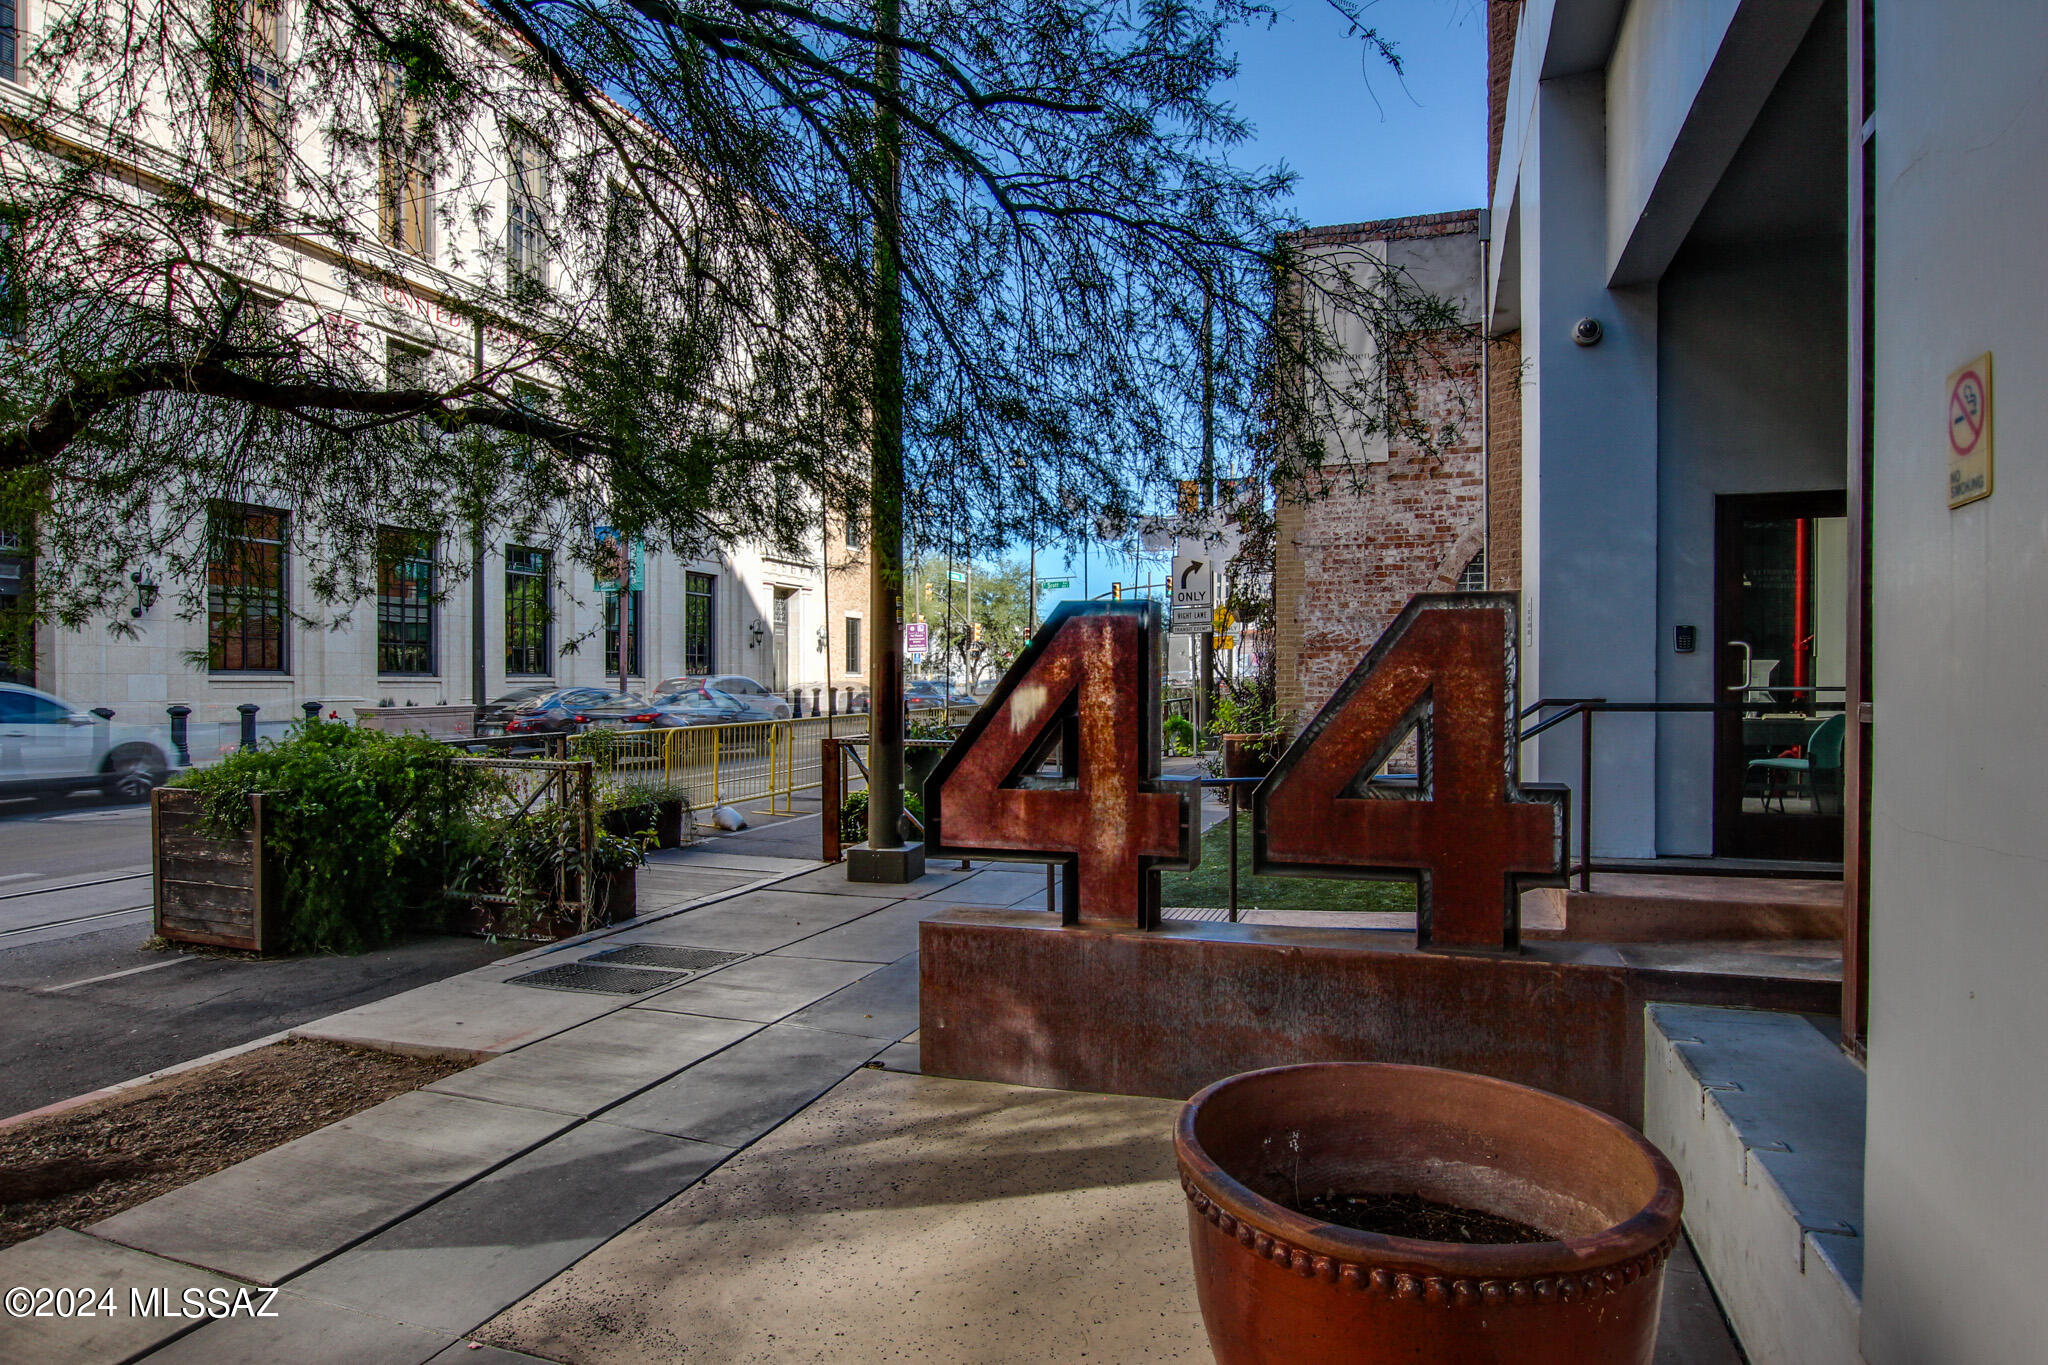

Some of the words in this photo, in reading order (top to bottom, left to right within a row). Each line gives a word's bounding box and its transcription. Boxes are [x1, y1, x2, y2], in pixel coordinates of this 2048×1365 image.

[1951, 470, 1960, 482] NO
[1951, 475, 1984, 498] SMOKING
[1178, 592, 1206, 602] ONLY
[1194, 611, 1207, 619] LANE
